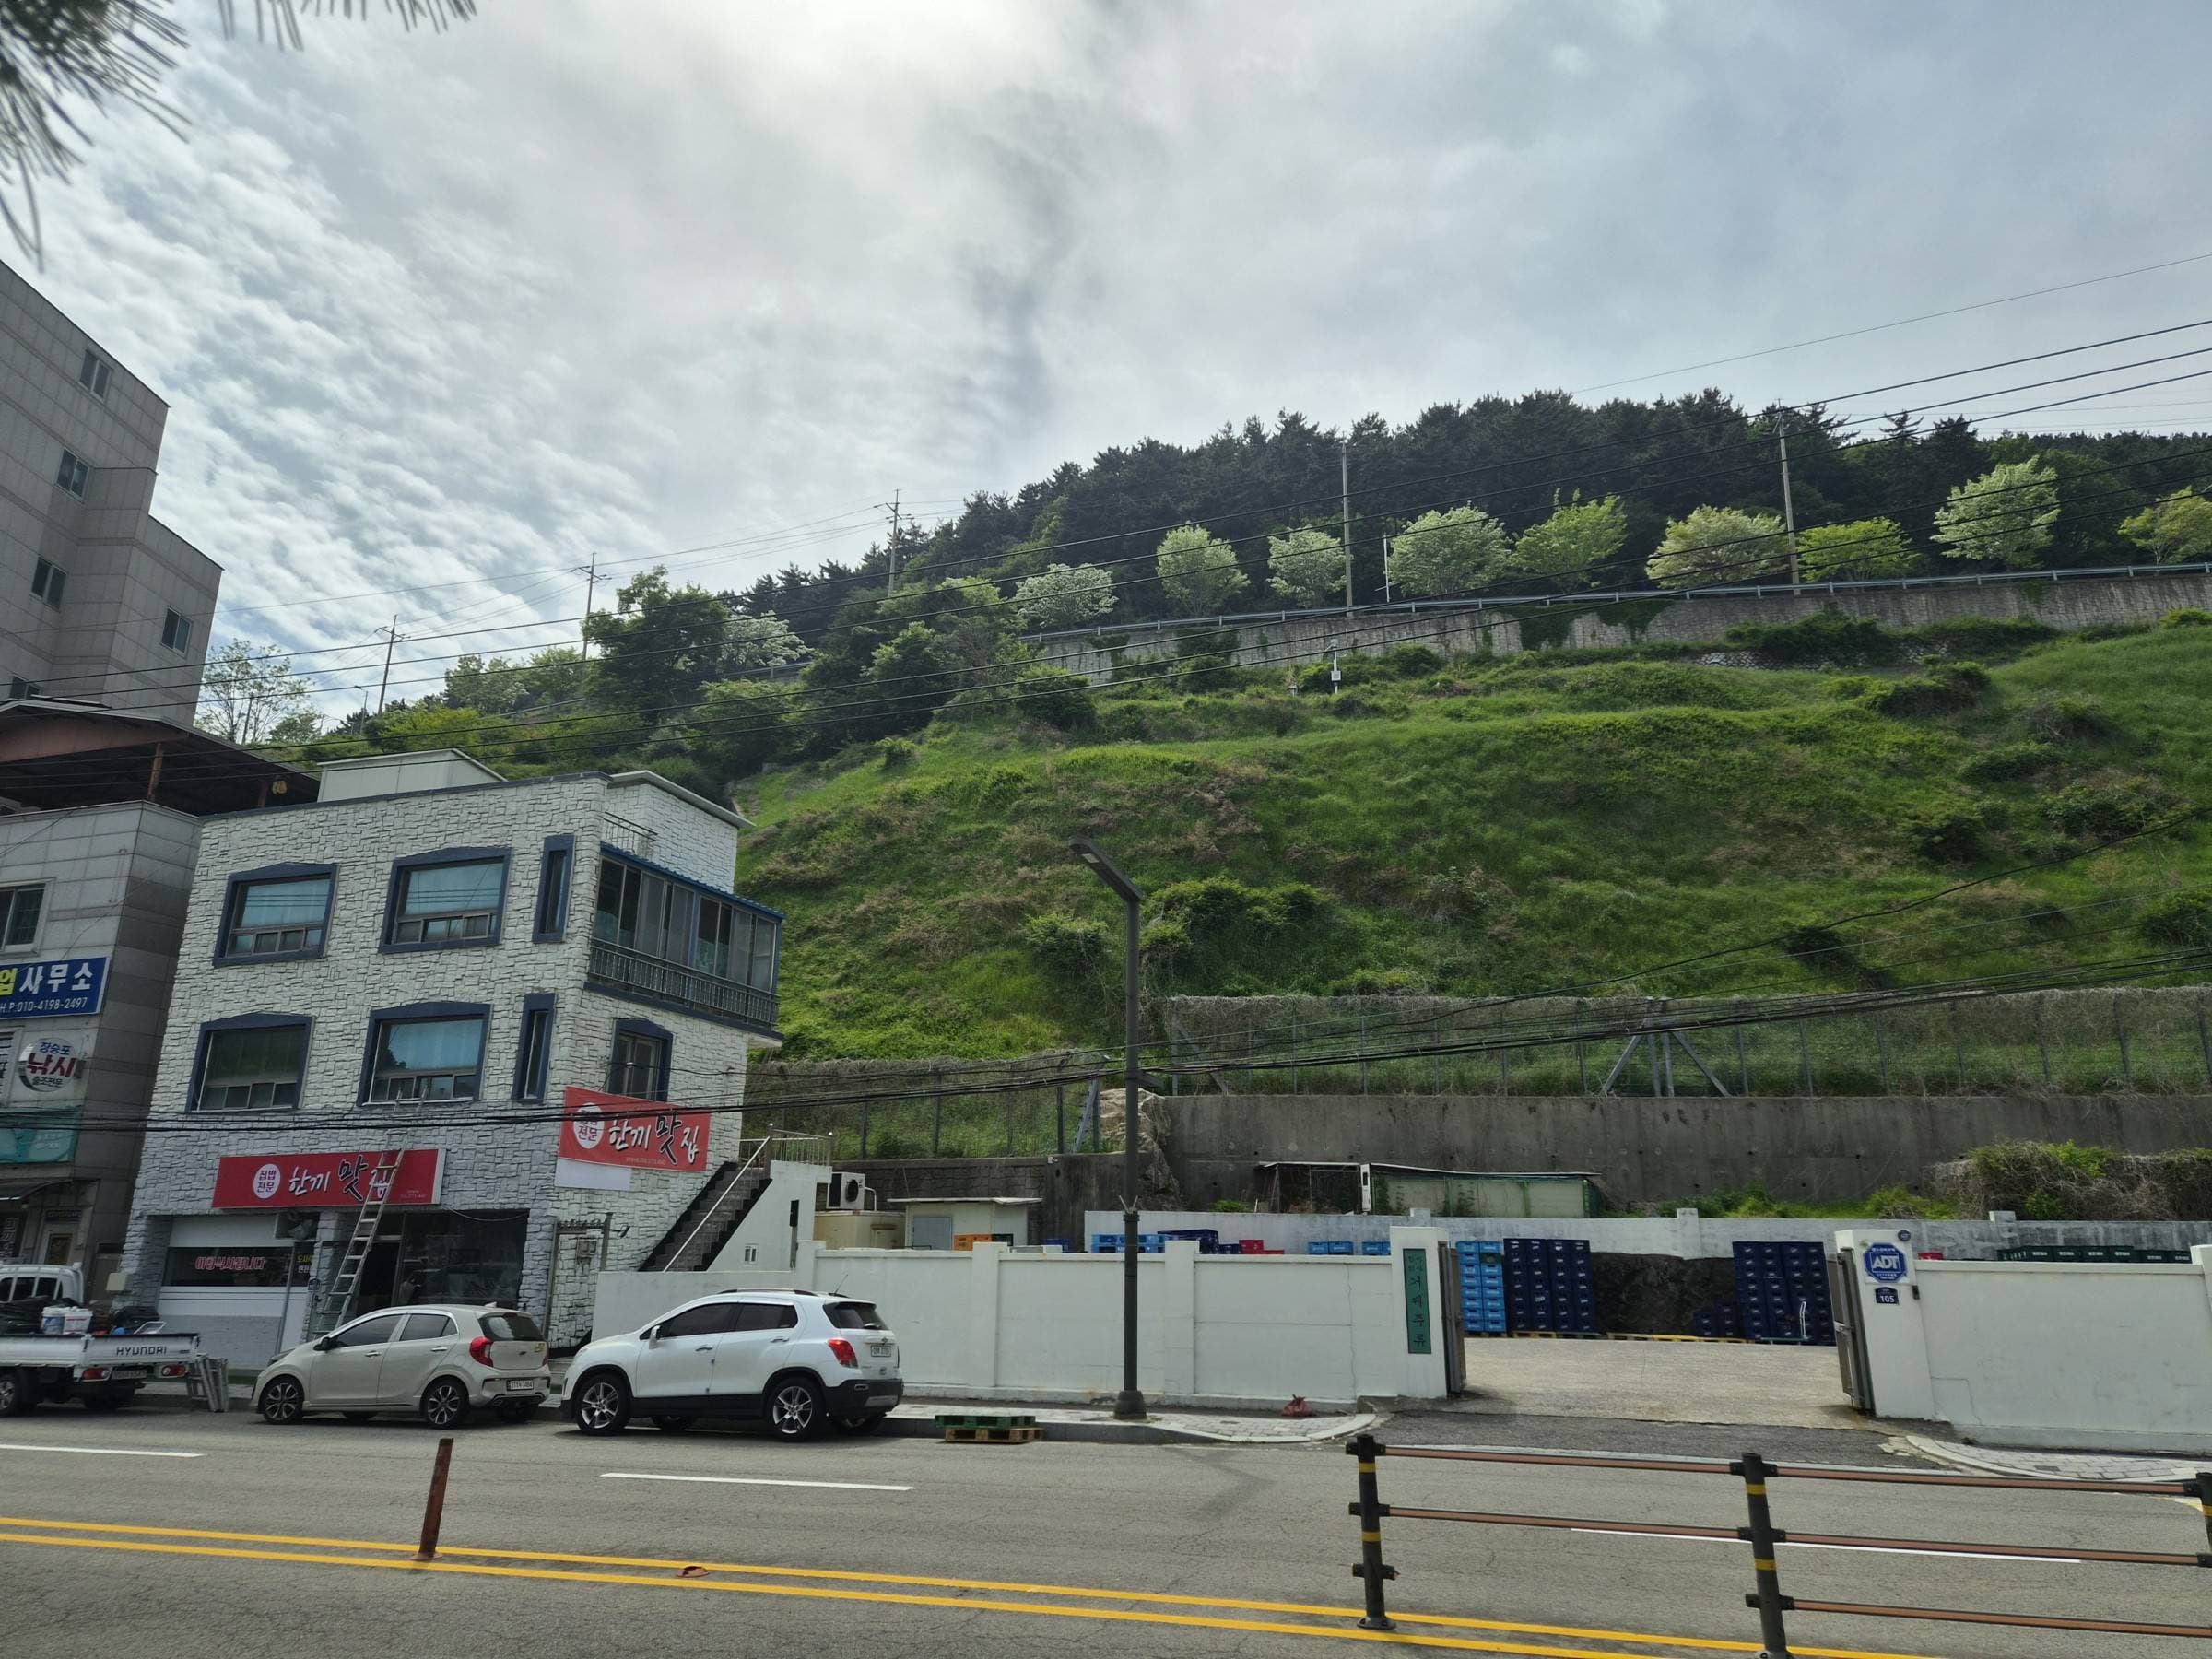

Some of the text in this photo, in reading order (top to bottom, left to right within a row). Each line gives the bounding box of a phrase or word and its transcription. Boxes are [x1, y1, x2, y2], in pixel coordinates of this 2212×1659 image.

[27, 1053, 76, 1078] 낚시
[578, 1125, 598, 1142] 전문
[609, 1108, 700, 1165] 한끼 맛집
[258, 1169, 277, 1181] 집밥
[288, 1166, 331, 1197] 한끼
[256, 1181, 276, 1194] 전문
[1872, 1254, 1900, 1269] ADT
[1879, 1295, 1895, 1303] 105
[116, 1346, 167, 1356] HYUNDAI
